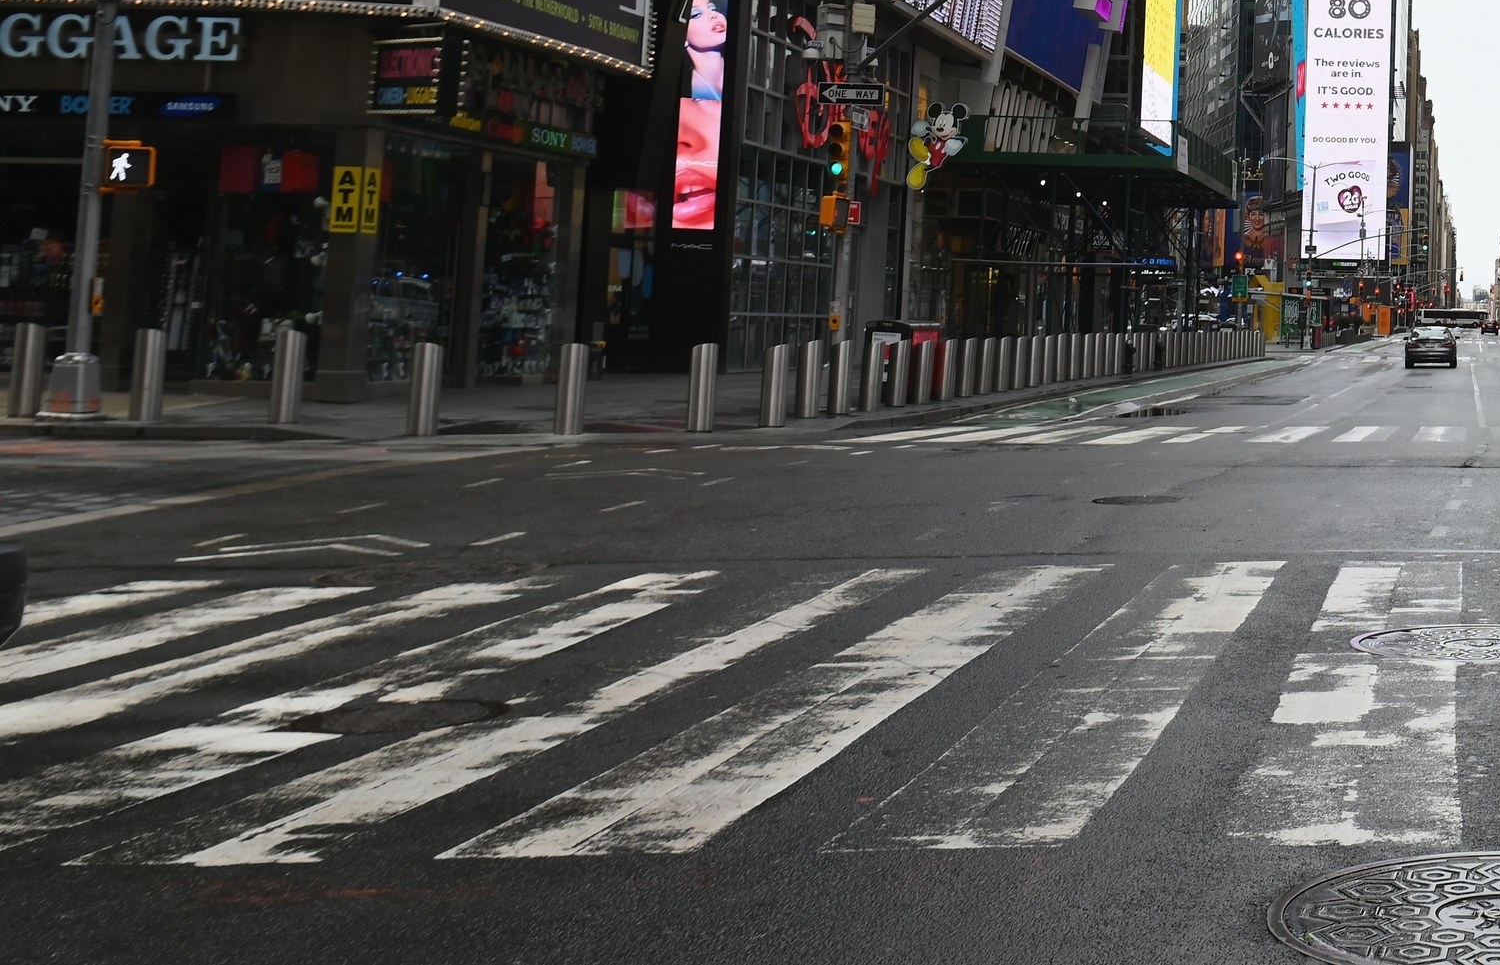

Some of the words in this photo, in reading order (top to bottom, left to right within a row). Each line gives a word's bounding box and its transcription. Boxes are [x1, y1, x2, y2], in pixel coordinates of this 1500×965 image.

[1313, 27, 1384, 40] CALORIES
[1314, 58, 1335, 67] The
[1337, 58, 1380, 68] reviews
[1330, 70, 1349, 78] are
[1351, 69, 1363, 78] in.
[828, 89, 847, 98] ONE
[855, 89, 876, 99] WAY
[1317, 86, 1338, 95] IT'S
[1341, 86, 1375, 96] GOOD.
[166, 102, 215, 112] SAMSUNG
[531, 128, 568, 148] SONY
[571, 137, 598, 154] BOWER
[1324, 172, 1346, 186] TWO
[1348, 171, 1370, 182] GOOD
[335, 170, 356, 223] ATM
[364, 172, 377, 224] ATM
